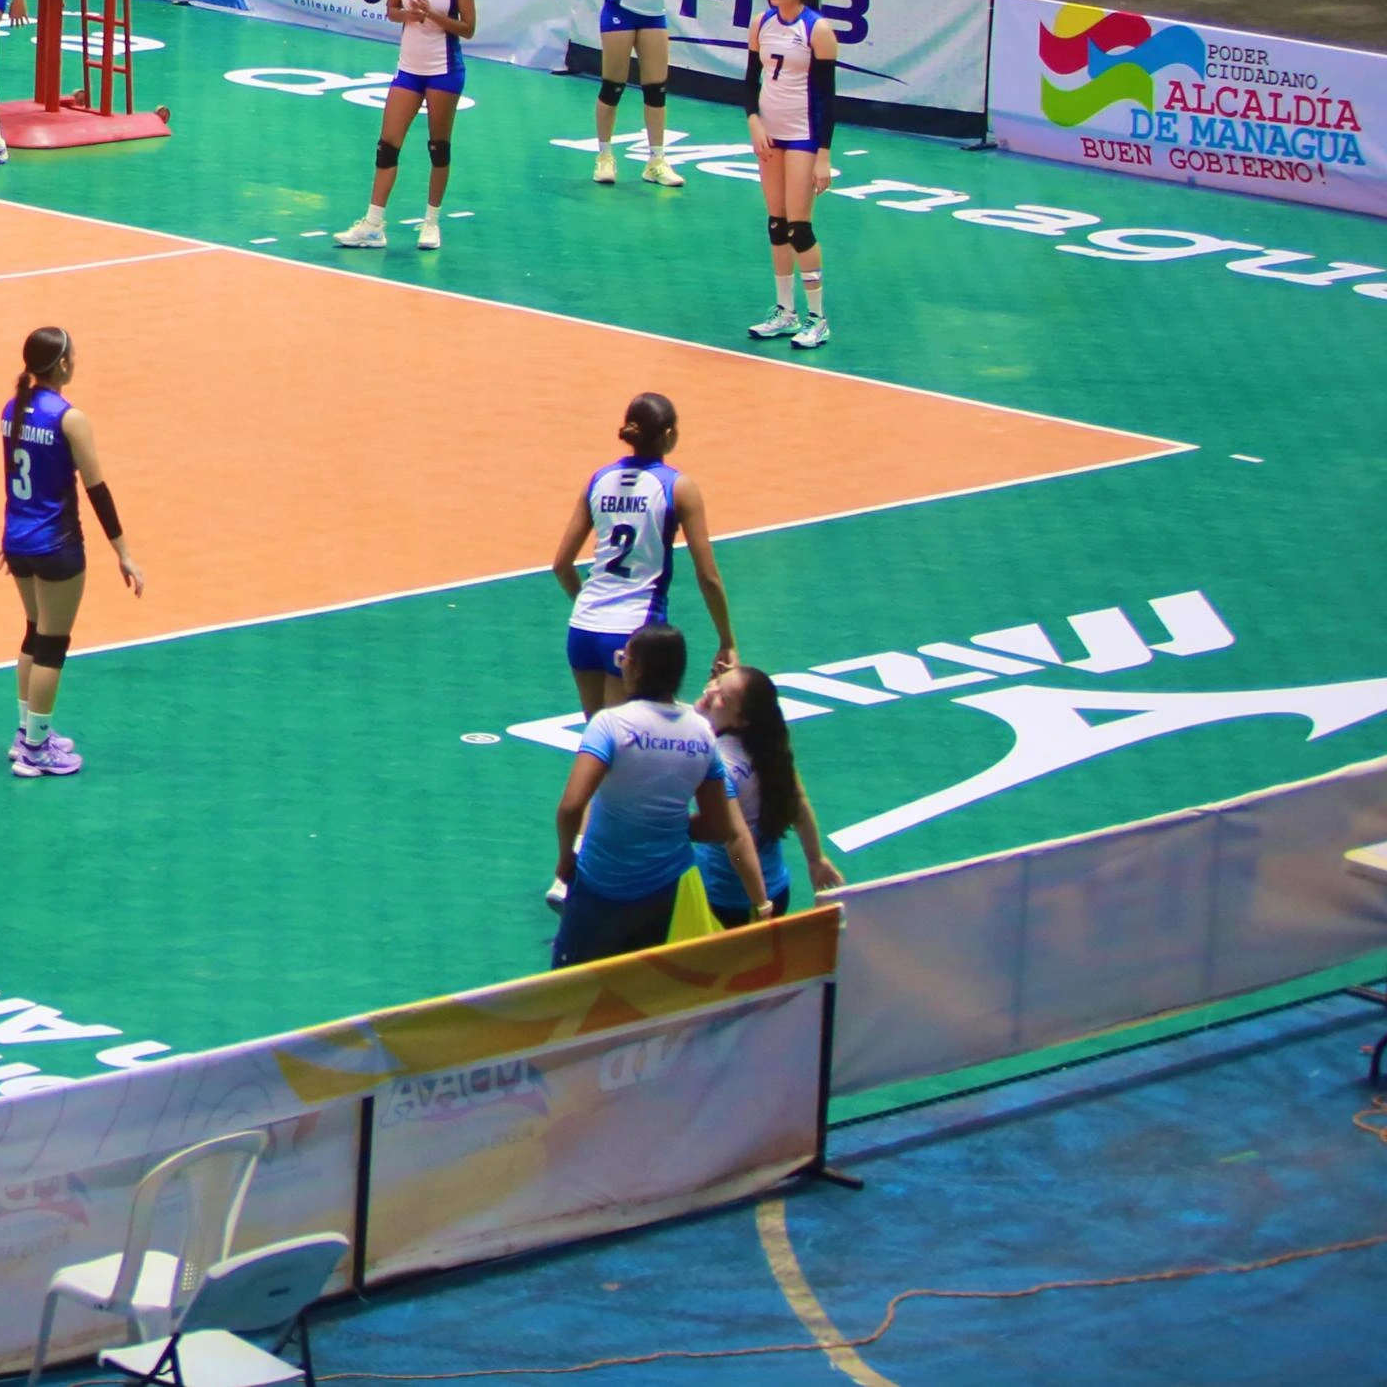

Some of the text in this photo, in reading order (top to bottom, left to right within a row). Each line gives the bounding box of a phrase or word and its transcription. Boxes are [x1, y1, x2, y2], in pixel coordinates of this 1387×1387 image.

[769, 54, 784, 80] 7
[1208, 44, 1269, 66] PODER
[1206, 63, 1317, 90] CIUDADANO
[1164, 81, 1361, 132] ALCALDÍA
[1130, 109, 1367, 166] DE MANAGUA
[1080, 137, 1327, 185] BUEN GOBIERNO!
[12, 448, 32, 501] 3
[600, 495, 648, 513] EBANKS
[604, 524, 637, 579] 2
[626, 731, 710, 757] Nicaragua
